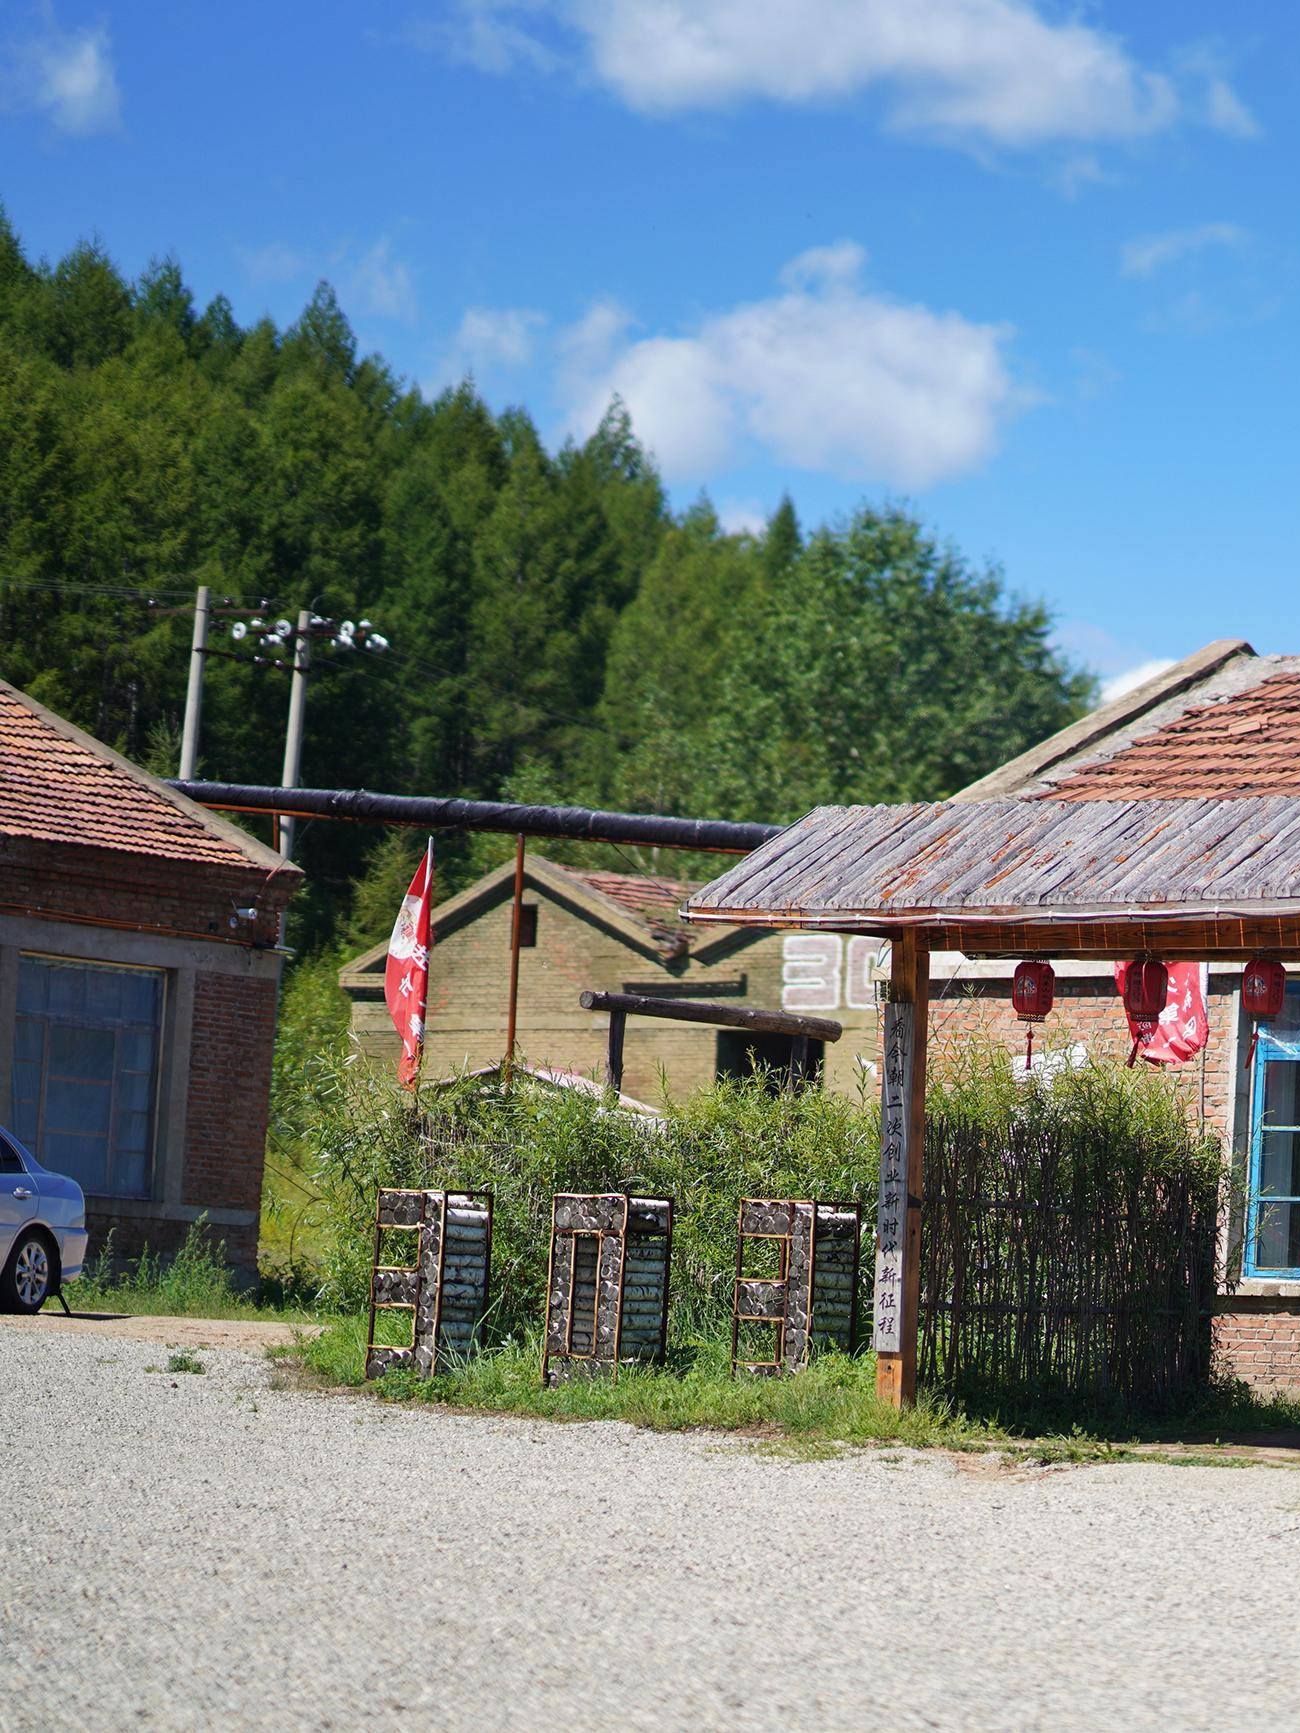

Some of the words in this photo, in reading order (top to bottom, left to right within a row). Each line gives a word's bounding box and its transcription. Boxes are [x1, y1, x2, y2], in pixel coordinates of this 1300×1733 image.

[878, 1016, 908, 1336] 看今朝二次创业新时代新征程
